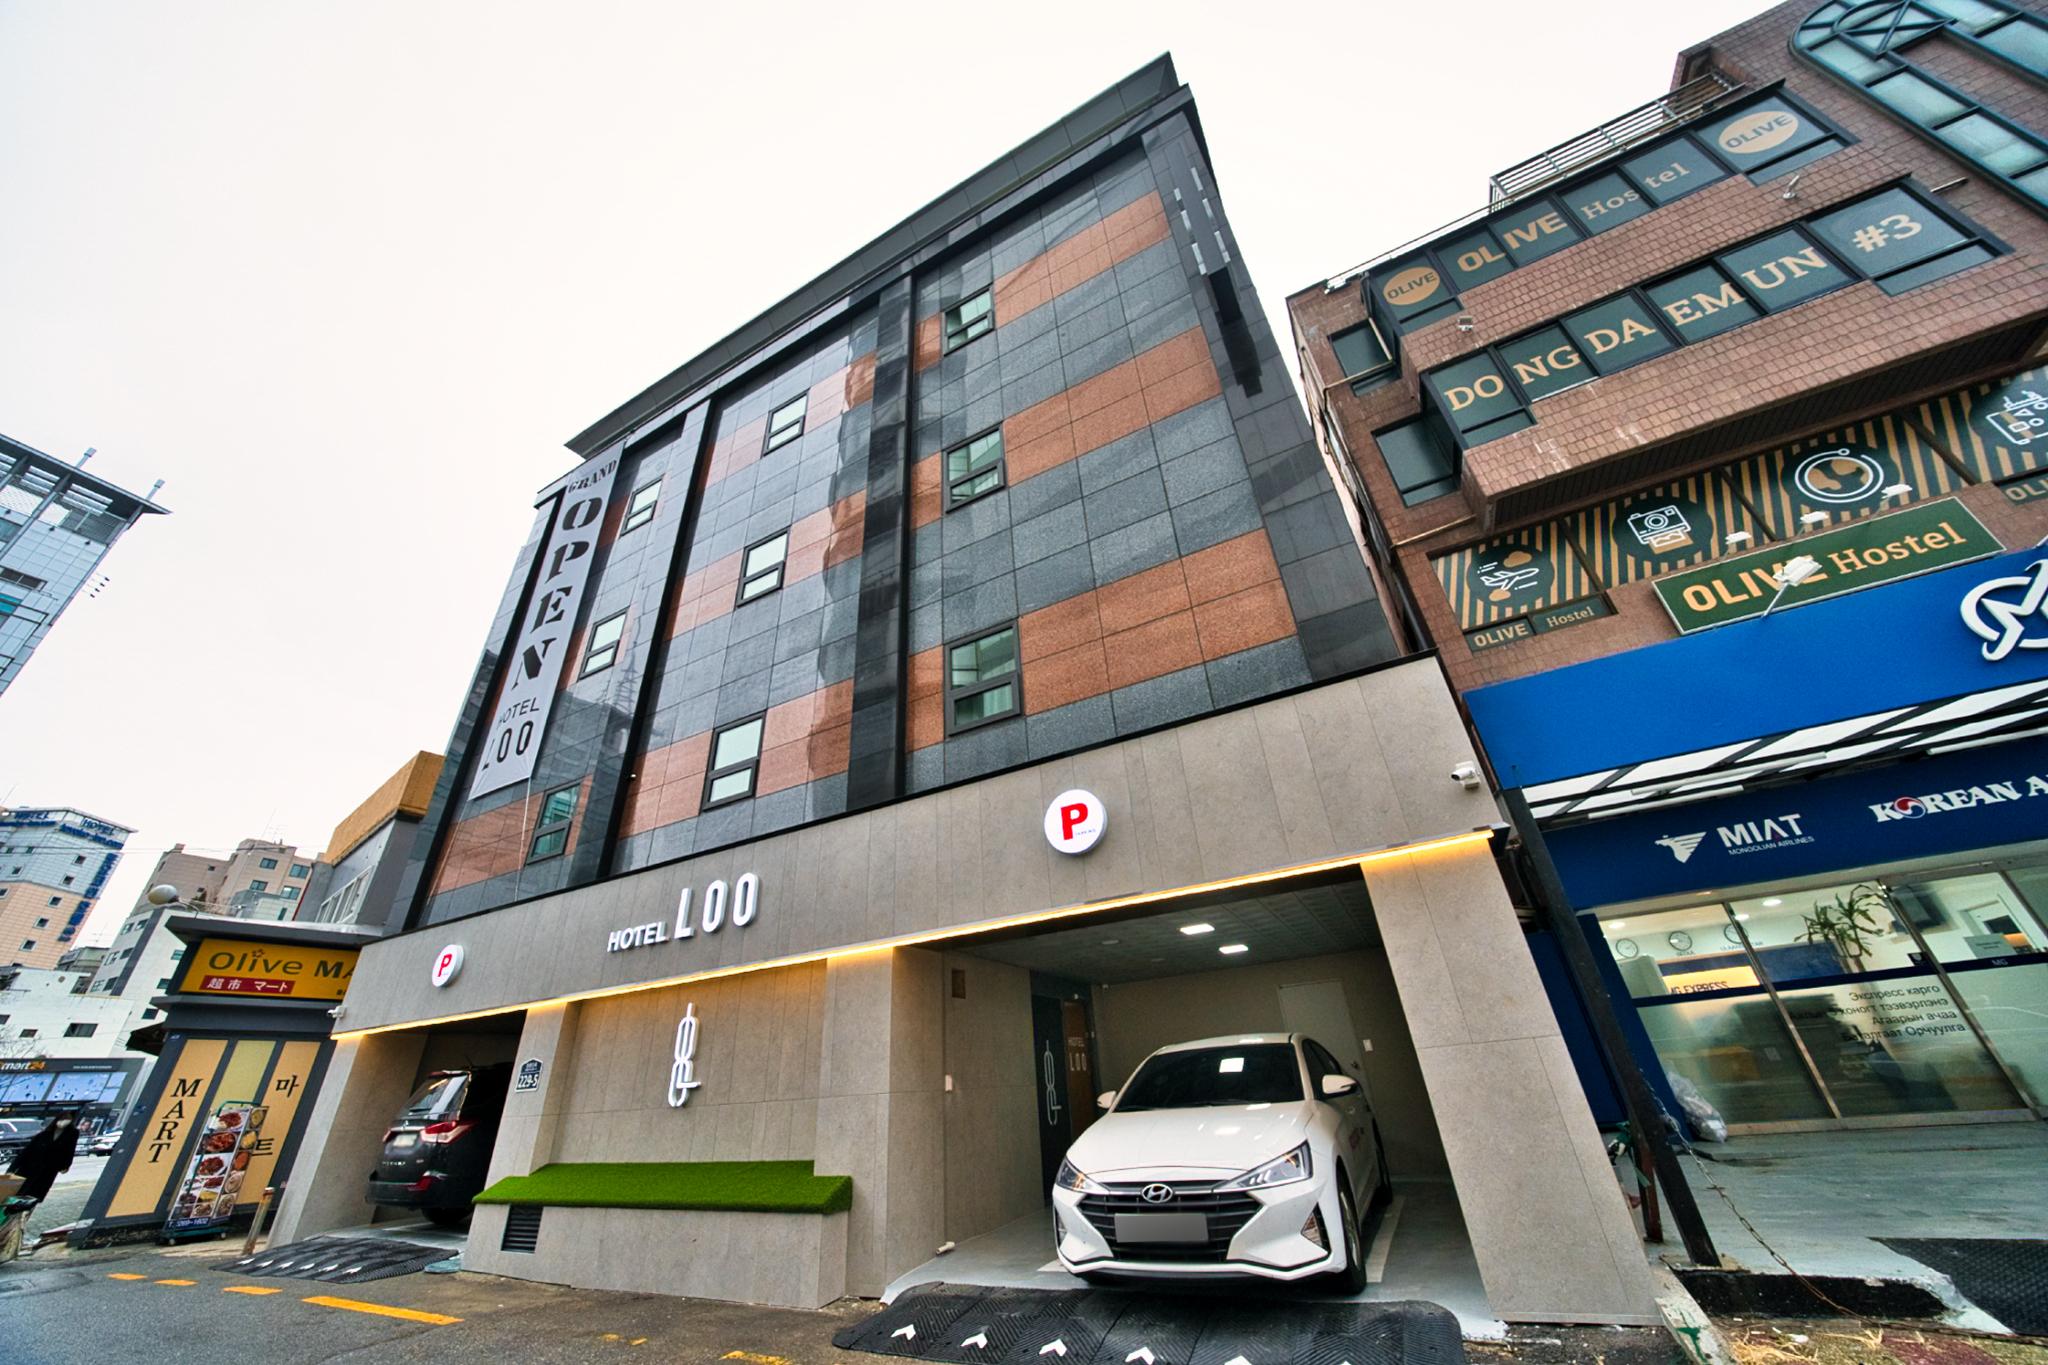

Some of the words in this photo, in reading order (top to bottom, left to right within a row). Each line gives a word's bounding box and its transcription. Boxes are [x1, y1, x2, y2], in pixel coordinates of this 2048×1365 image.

[1726, 114, 1793, 149] OLIVE
[1456, 211, 1568, 272] OLIVE
[1580, 162, 1691, 220] Hostel
[1852, 213, 1923, 253] #3
[1386, 271, 1438, 299] OLIVE
[568, 459, 617, 494] GRAND
[1827, 522, 1968, 575] Hostel
[511, 497, 604, 690] OPEN
[1473, 623, 1529, 647] OLIVE
[1546, 606, 1595, 628] Hostel
[1868, 781, 2022, 823] KOREAN
[1061, 803, 1088, 840] P
[1716, 813, 1803, 848] MIAT
[1728, 843, 1777, 855] MONGOLIAN
[1778, 836, 1815, 847] AIRLINES
[607, 920, 670, 952] HOTEL
[674, 872, 760, 939] LOO
[208, 951, 303, 975] Olive
[437, 953, 453, 977] P
[148, 1078, 203, 1163] MART
